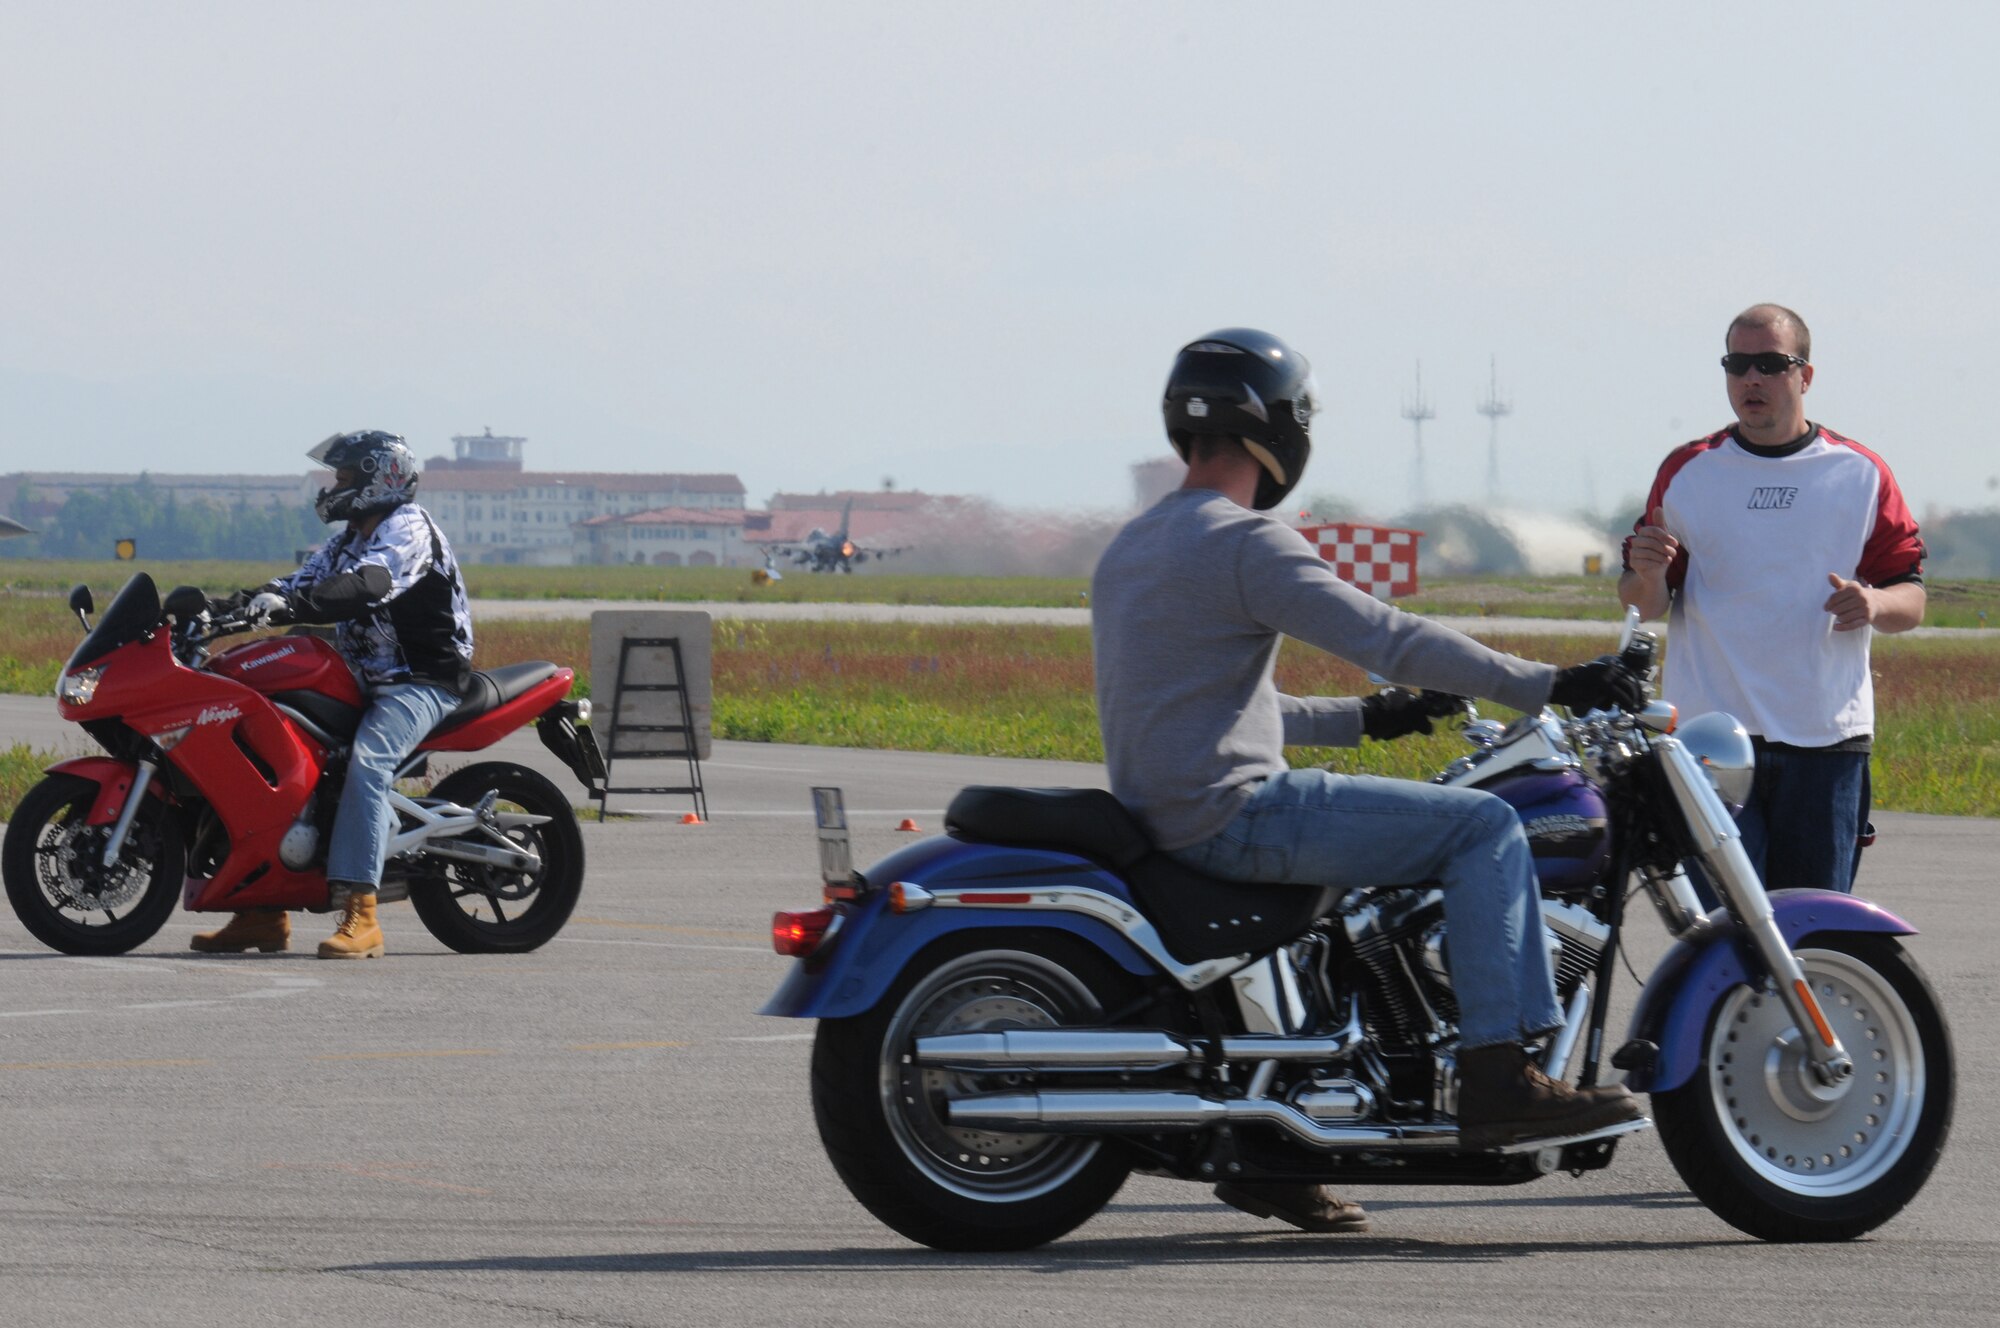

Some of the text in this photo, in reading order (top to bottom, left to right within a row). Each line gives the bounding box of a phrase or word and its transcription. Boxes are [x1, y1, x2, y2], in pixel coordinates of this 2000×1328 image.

[1747, 486, 1798, 509] NIKE
[240, 643, 296, 671] Kawasaki
[196, 703, 242, 726] Ninja
